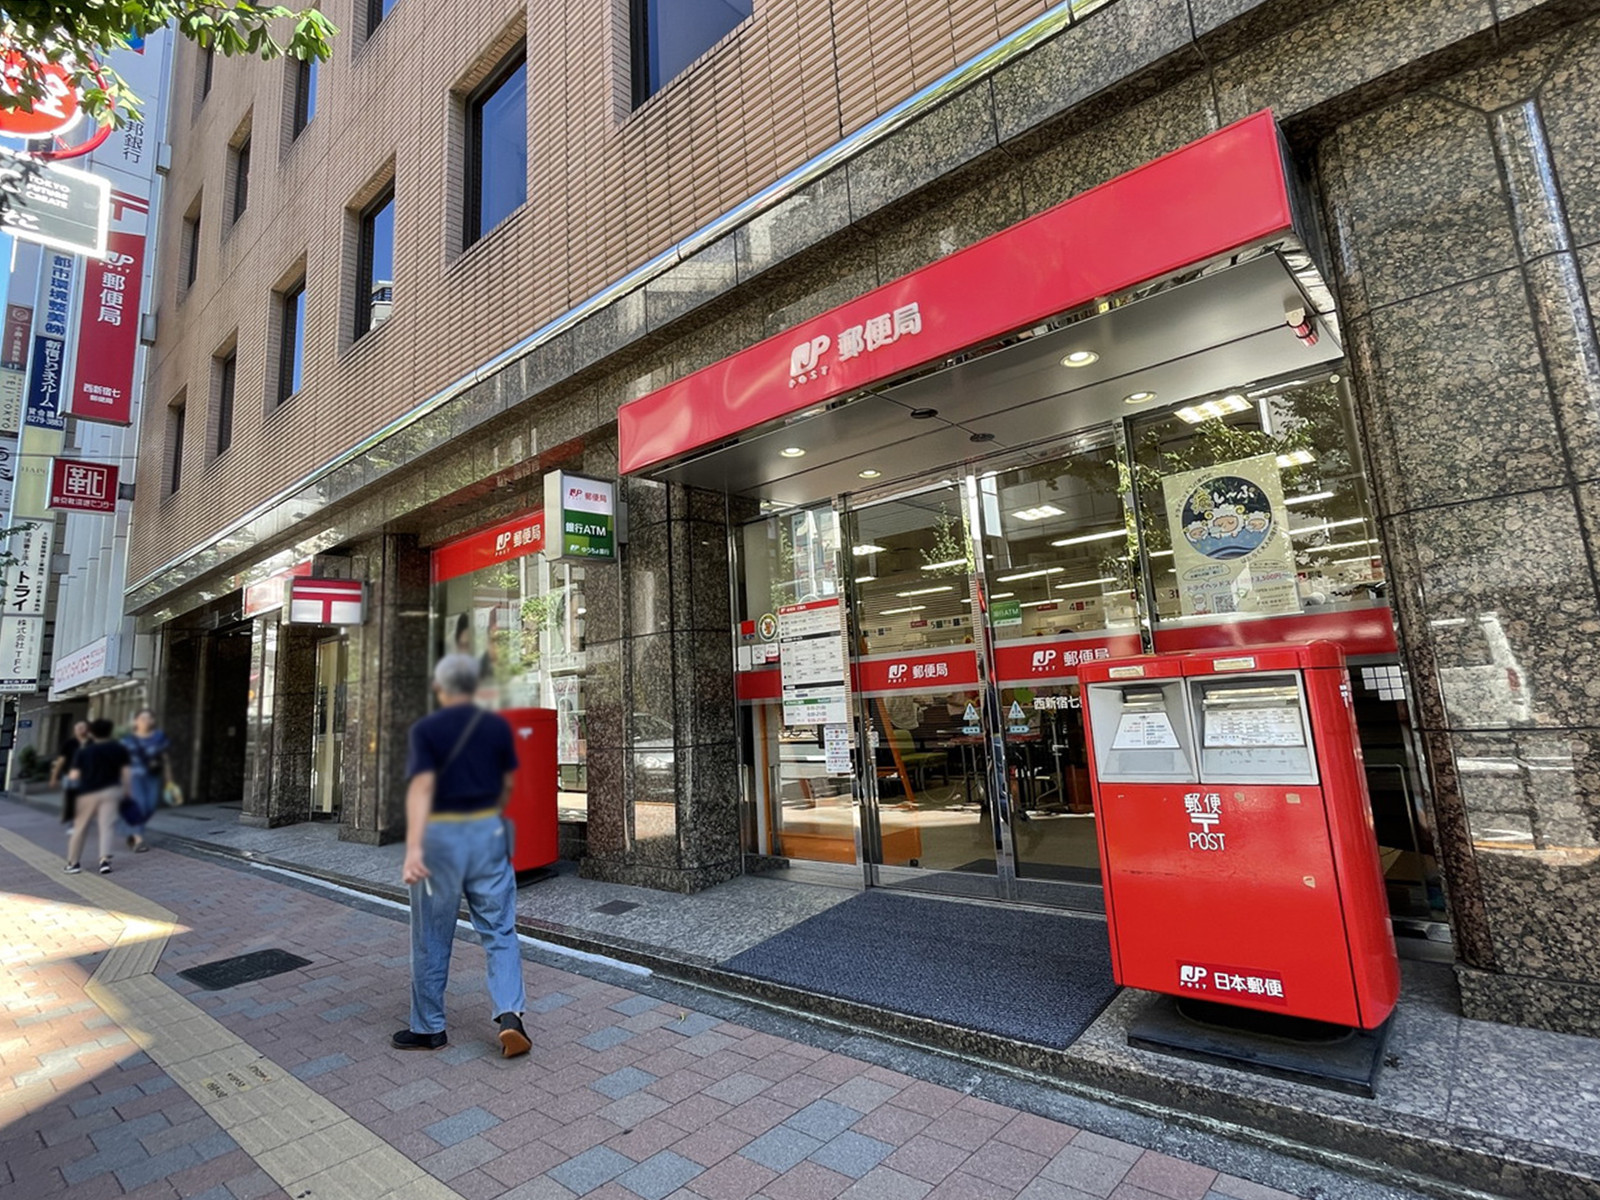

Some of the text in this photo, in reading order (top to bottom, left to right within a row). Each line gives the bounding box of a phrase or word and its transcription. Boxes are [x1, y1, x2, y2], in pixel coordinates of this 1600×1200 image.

[123, 114, 145, 163] 邦銀行
[97, 272, 126, 326] 郵便局
[837, 302, 922, 361] 郵便局
[790, 334, 831, 377] JP
[788, 365, 829, 389] POST
[1, 398, 14, 429] TOKYO
[68, 466, 103, 496] 靴
[584, 492, 607, 503] 郵便局
[513, 524, 541, 548] 郵便局
[565, 522, 606, 536] 銀行ATM
[496, 531, 511, 551] JP
[12, 570, 31, 611] トライ
[1033, 649, 1057, 666] JP
[888, 664, 908, 679] JP
[912, 663, 948, 679] 郵便局
[1033, 695, 1083, 710] 西新宿七
[1184, 793, 1222, 815] 郵便
[1189, 832, 1225, 851] POST
[1180, 965, 1207, 982] JP
[1213, 972, 1285, 998] 日本郵便
